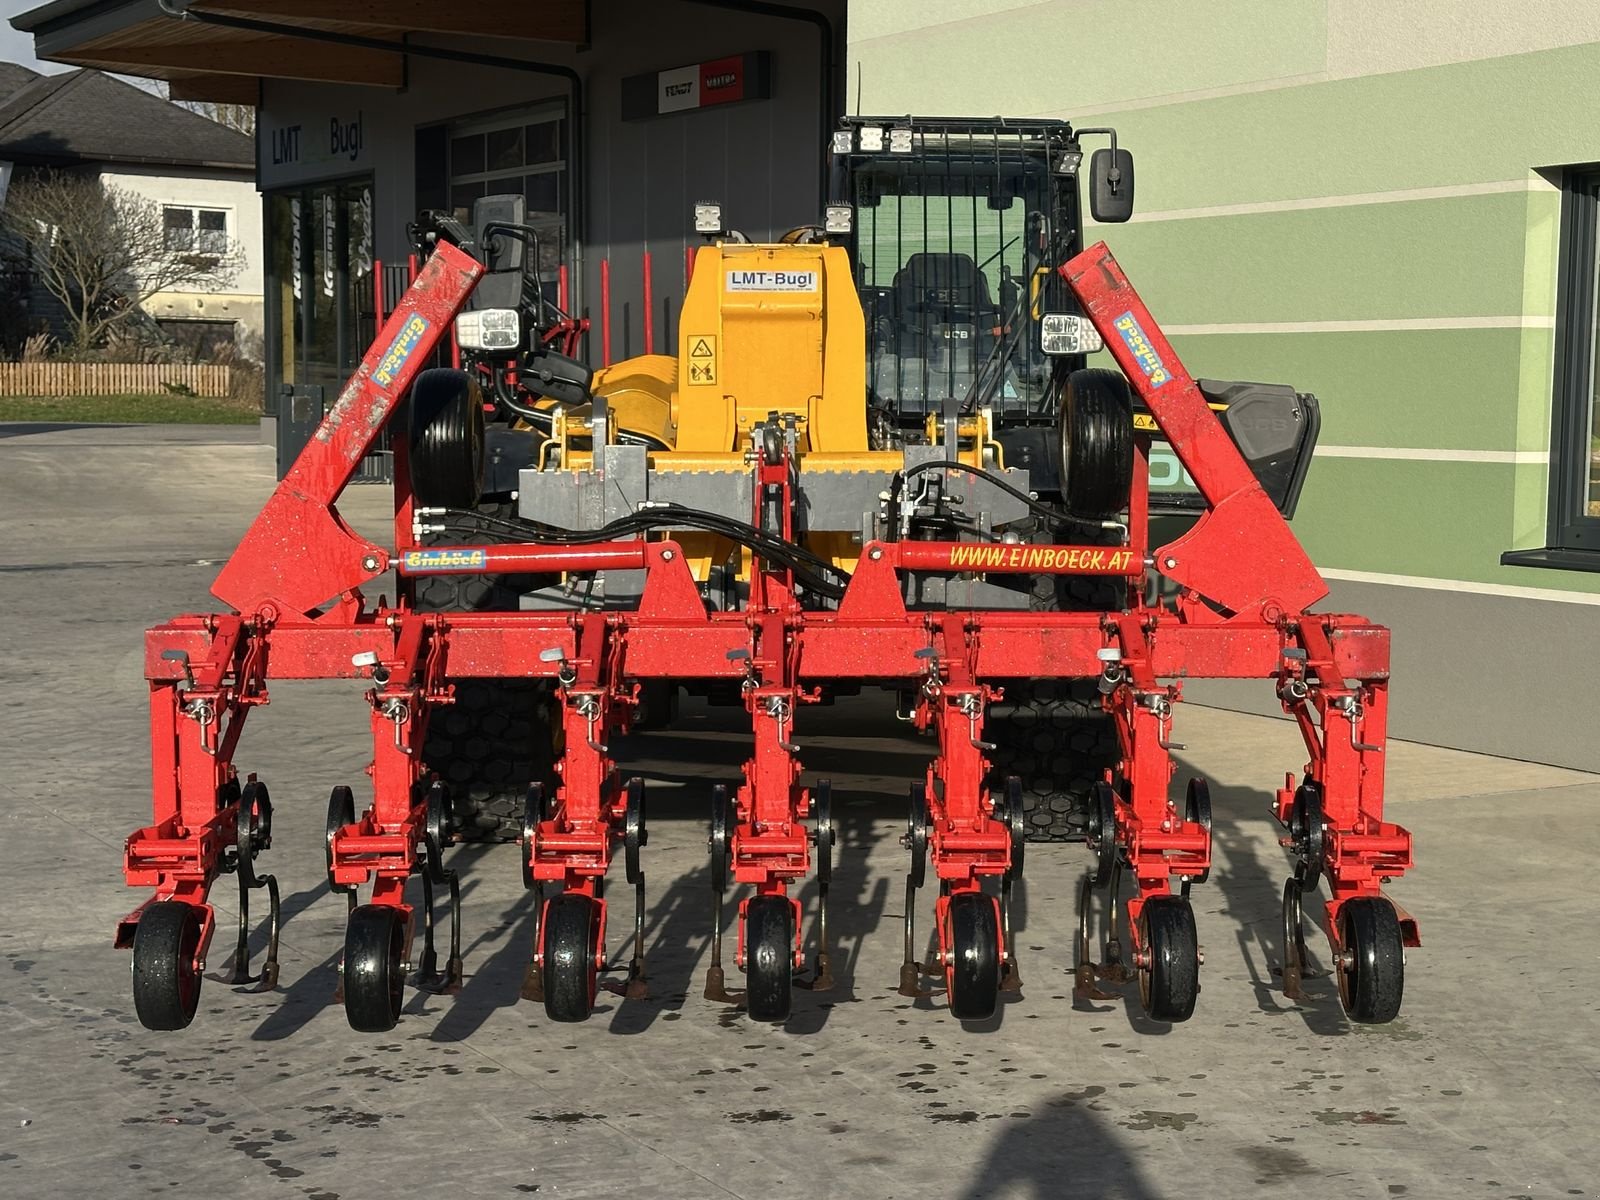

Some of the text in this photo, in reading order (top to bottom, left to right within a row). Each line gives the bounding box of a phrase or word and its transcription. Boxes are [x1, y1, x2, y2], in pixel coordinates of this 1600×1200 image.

[665, 81, 693, 97] FENDT
[272, 110, 363, 165] LMT Bugl
[291, 199, 302, 299] KRONE
[732, 272, 812, 288] LMT-Bugl
[407, 550, 482, 566] Einböck
[950, 546, 1133, 570] WWW.EINBOECK.AT
